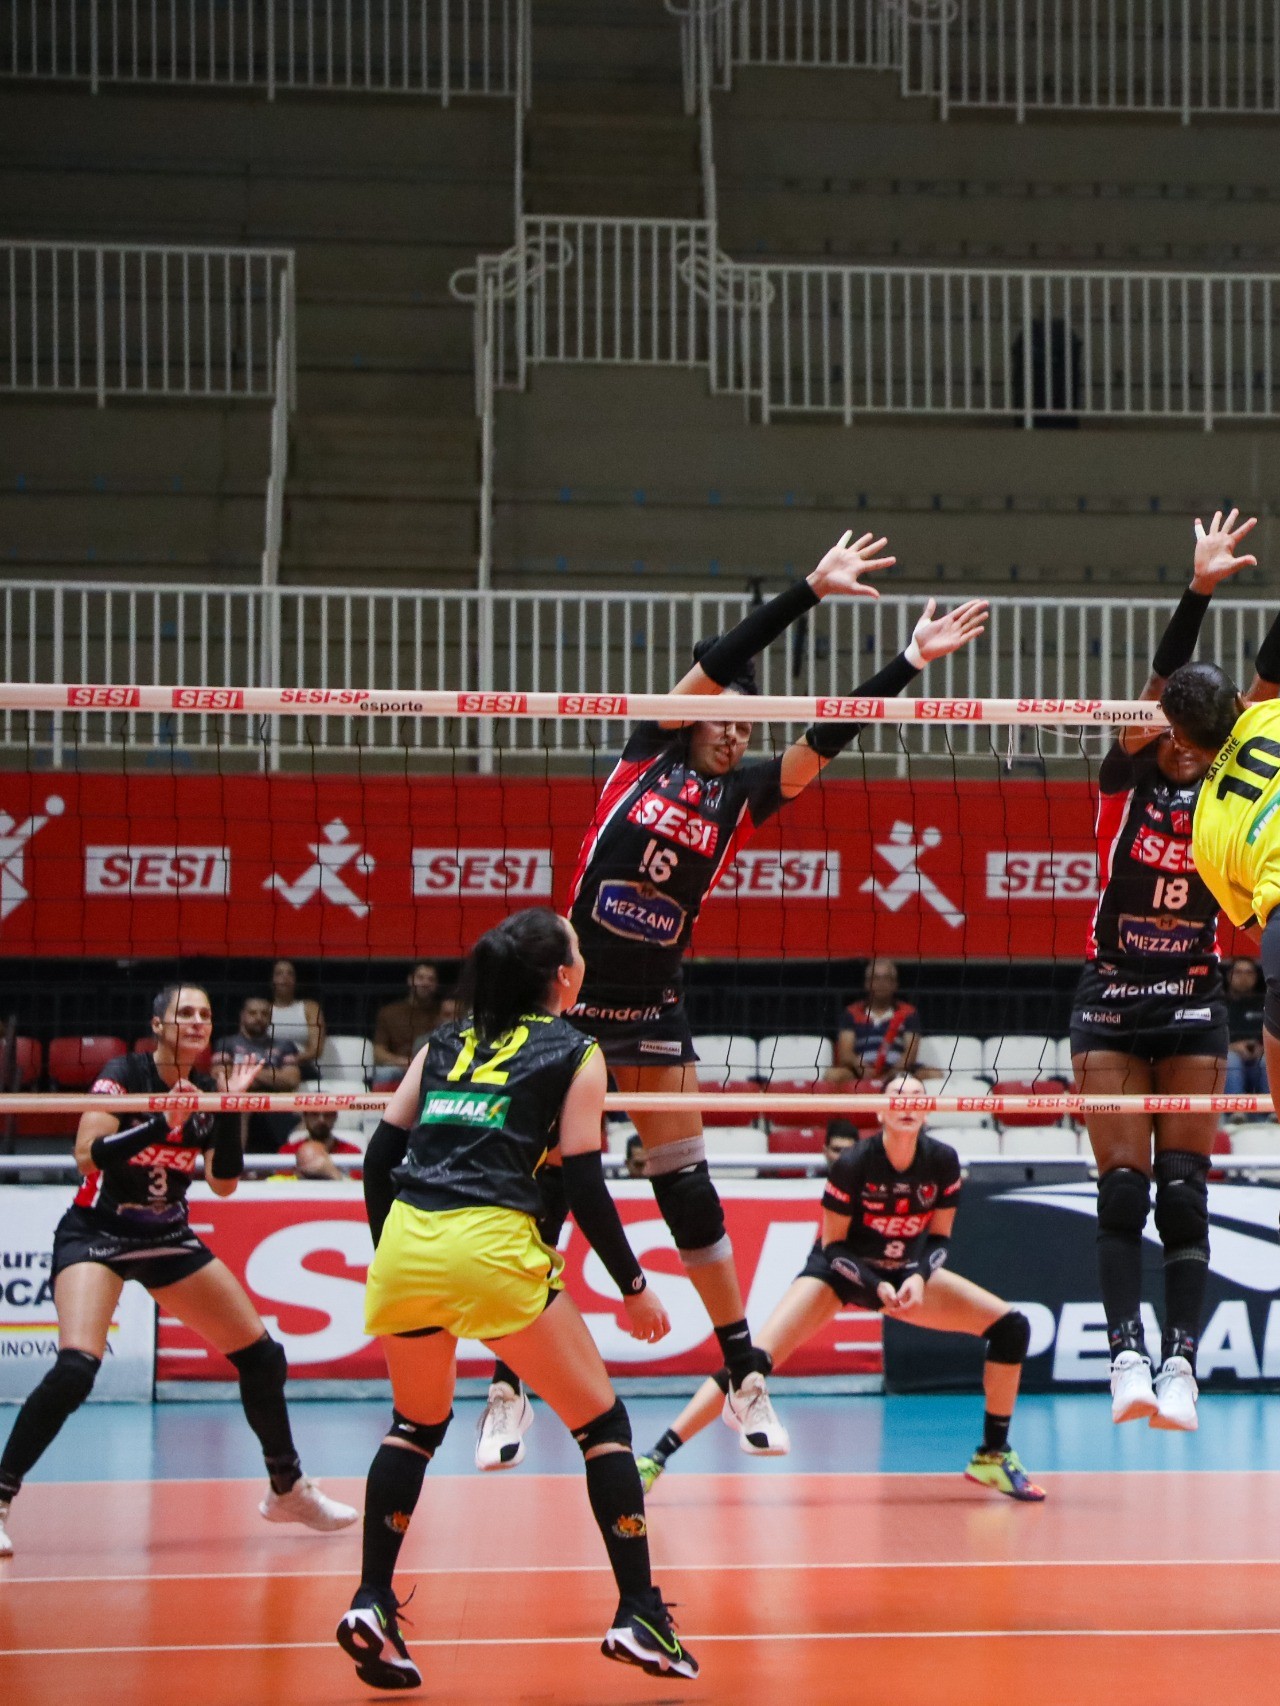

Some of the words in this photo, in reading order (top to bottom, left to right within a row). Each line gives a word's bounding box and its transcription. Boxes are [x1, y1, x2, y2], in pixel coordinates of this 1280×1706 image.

[73, 688, 134, 706] SESI
[178, 690, 239, 708] SESI
[280, 689, 369, 704] SESI-SP
[463, 695, 522, 713] SESI
[564, 696, 622, 714] SESI
[360, 700, 423, 714] esporte
[823, 701, 878, 718] SESI
[921, 701, 977, 719] SESI
[1017, 699, 1101, 713] SESI-SP
[1093, 708, 1154, 723] esporte
[1205, 737, 1241, 782] SALOME
[636, 799, 712, 850] SESI
[638, 839, 679, 882] 16
[1139, 835, 1197, 870] SE
[99, 853, 216, 888] SESI
[425, 855, 538, 890] SESI
[717, 857, 827, 891] SESI
[1001, 859, 1099, 892] SES
[1152, 876, 1189, 910] 18
[605, 897, 674, 931] MEZZANI
[447, 1026, 529, 1085] 12
[152, 1096, 195, 1109] SESI
[225, 1097, 266, 1109] SESI
[349, 1102, 387, 1111] esport
[427, 1098, 488, 1116] HELIAR
[894, 1098, 932, 1110] SESI
[962, 1098, 1001, 1111] SESI
[1079, 1103, 1121, 1112] esporte
[1148, 1098, 1188, 1110] SESI
[1215, 1098, 1254, 1110] SESI
[148, 1167, 168, 1196] 3
[0, 1252, 53, 1268] ura
[245, 1220, 819, 1364] SSI
